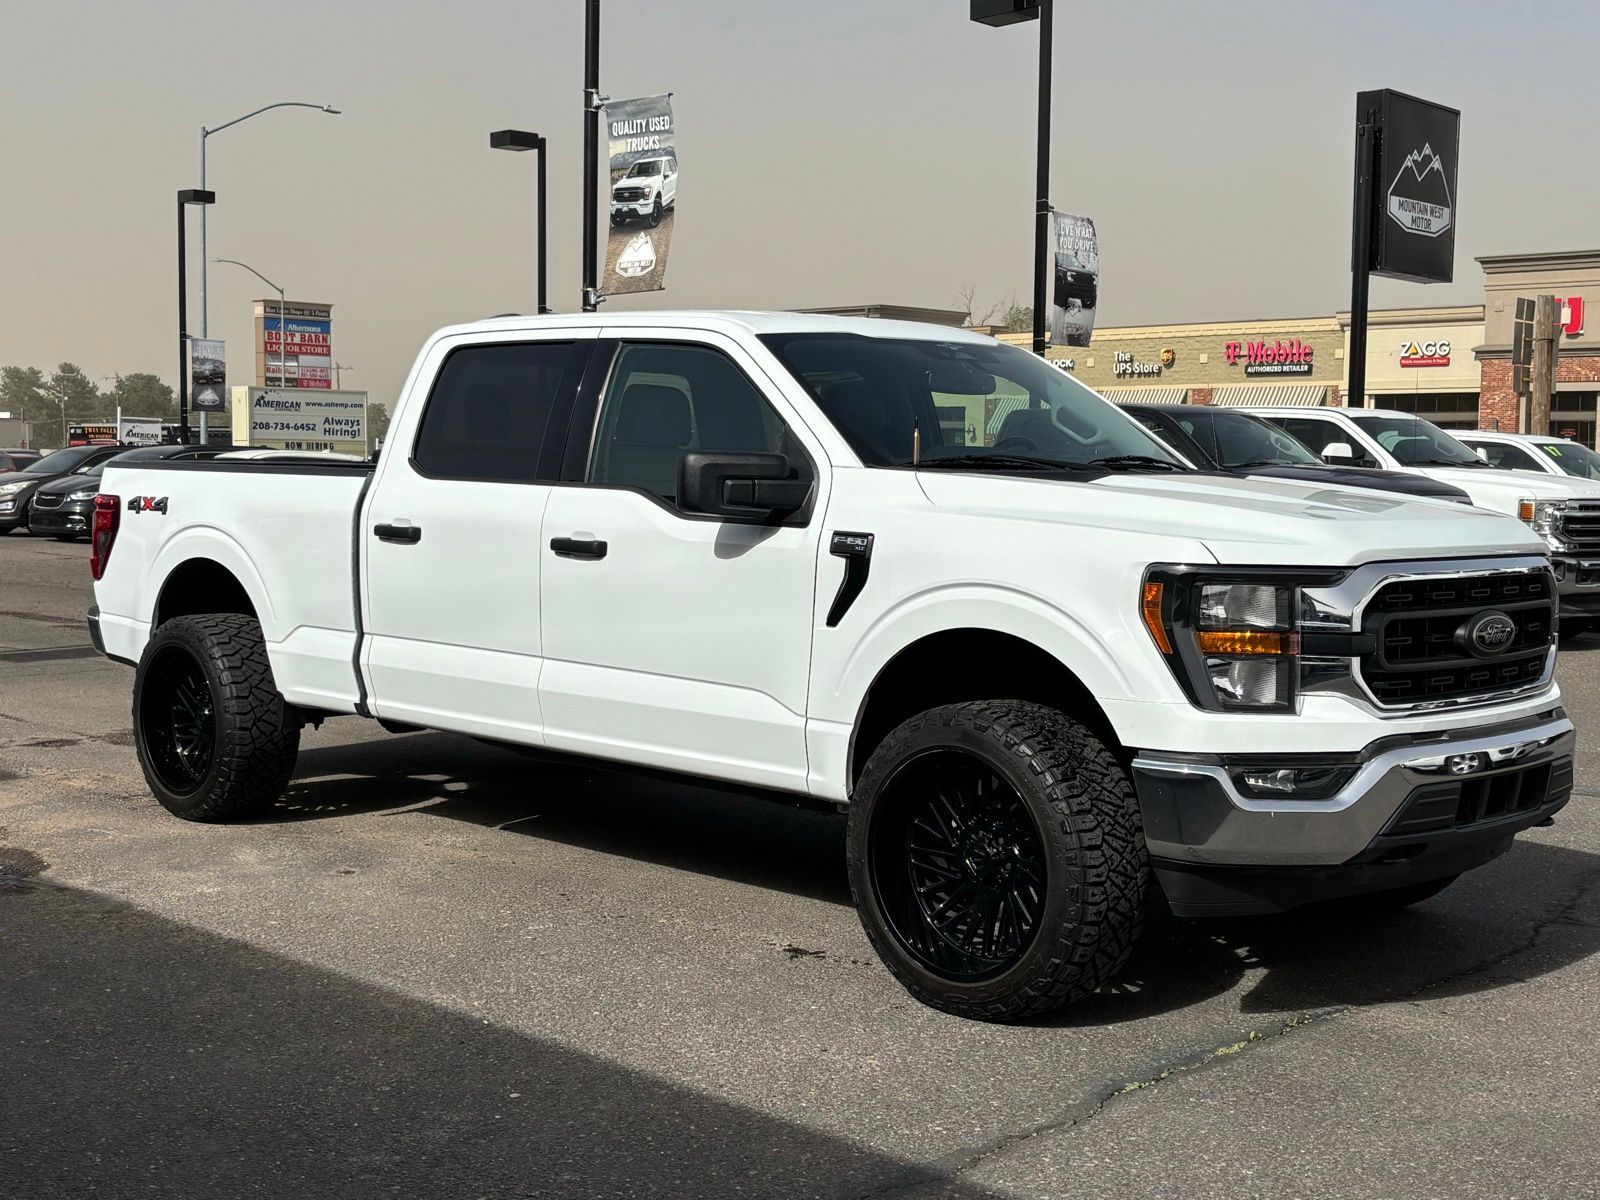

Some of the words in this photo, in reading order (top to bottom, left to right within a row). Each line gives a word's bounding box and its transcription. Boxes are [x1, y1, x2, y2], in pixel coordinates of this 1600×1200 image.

[612, 118, 647, 137] QUALITY
[649, 116, 670, 131] USED
[626, 135, 660, 152] TRUCKS
[1398, 199, 1429, 217] MOUNTAIN
[1430, 205, 1444, 220] WEST
[1411, 215, 1432, 230] MOTOR
[1060, 223, 1074, 236] OVE
[1060, 236, 1073, 249] YOU
[1074, 239, 1094, 252] DRIVE
[287, 323, 321, 333] Albertsons
[300, 333, 328, 344] BARN
[301, 345, 329, 354] STORE
[1224, 338, 1313, 363] T-Mobile
[1400, 340, 1451, 357] ZAGG
[1113, 351, 1131, 362] The
[1113, 363, 1132, 374] UPS
[1133, 362, 1159, 374] Store
[254, 398, 302, 409] AMERICAN
[305, 401, 364, 409] www.asitemp.com
[252, 421, 317, 432] 208-734-6452
[323, 417, 361, 428] Always
[125, 430, 159, 439] AMERICAN
[323, 427, 361, 439] Hiring!
[285, 441, 302, 450] NOW
[306, 442, 335, 451] HIRING
[833, 536, 868, 546] F-150
[1478, 623, 1512, 644] Ford
